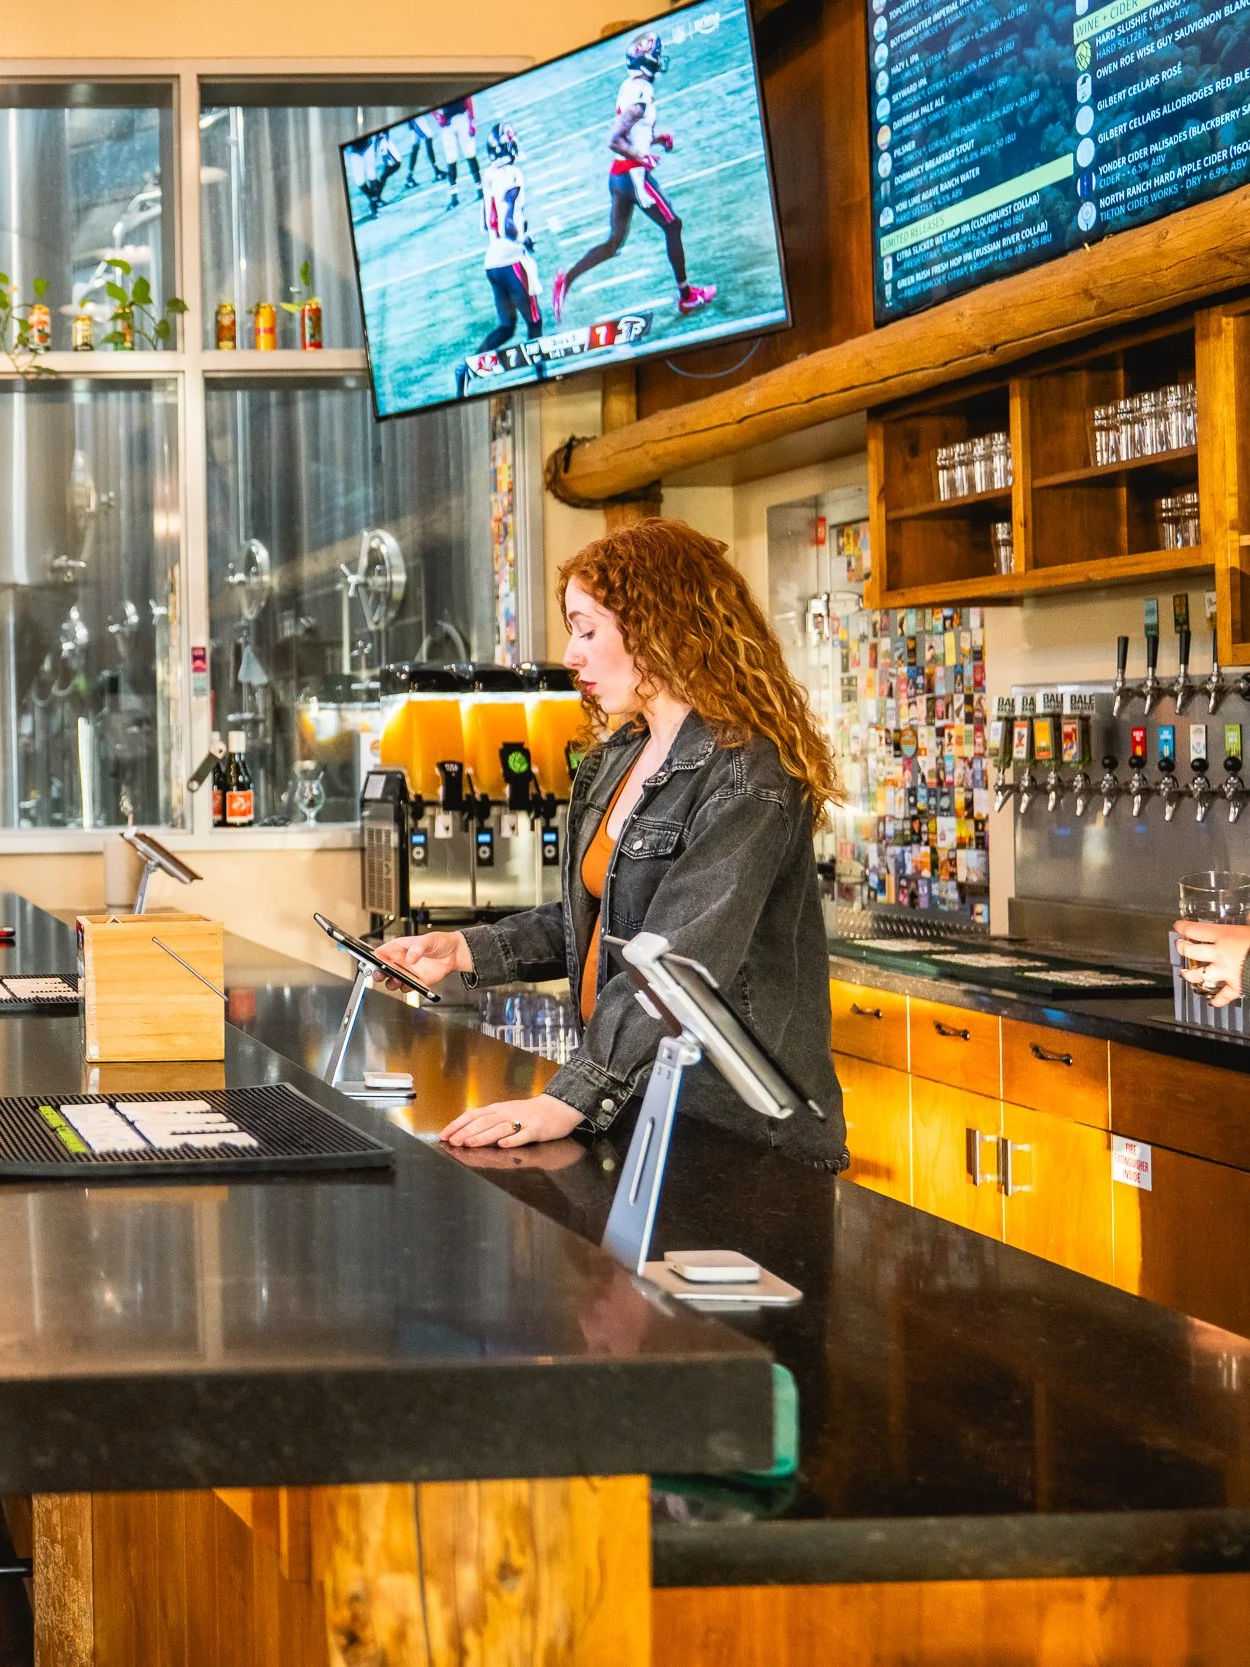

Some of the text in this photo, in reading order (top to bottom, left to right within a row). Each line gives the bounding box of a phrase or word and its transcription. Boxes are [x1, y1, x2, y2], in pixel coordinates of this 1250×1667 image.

[932, 1, 958, 24] IMPERIAL
[990, 18, 1001, 31] ABV
[1016, 4, 1027, 17] IBU
[1075, 14, 1099, 38] WINE
[1096, 27, 1115, 47] HARD
[1117, 11, 1147, 36] SLUSHIE
[1096, 4, 1190, 60] HARD SELTZER 6.3% ABV
[977, 55, 989, 67] ABV
[1003, 42, 1014, 54] IBU
[1096, 60, 1117, 79] OWEN
[1120, 51, 1134, 68] ROE
[1136, 41, 1154, 60] WISE
[1156, 33, 1172, 50] GUY
[1174, 9, 1221, 42] SAUVIGNON
[910, 51, 919, 65] IPA
[892, 76, 927, 103] SKYWARD IPA
[996, 75, 1007, 88] IBU
[1097, 59, 1182, 112] GILBERT CELLARS ROSÉ
[892, 95, 944, 131] DAYBREAK PALE ALE
[1002, 102, 1014, 115] ABV
[1028, 90, 1039, 102] IBU
[1097, 121, 1126, 144] GILBERT
[1128, 107, 1160, 130] CELLARS
[1162, 83, 1213, 116] ALLOBROGES
[1215, 75, 1231, 92] RED
[893, 139, 915, 159] PILSNER
[979, 144, 990, 156] ABV
[1005, 133, 1016, 145] IBU
[1098, 155, 1126, 176] YONDER
[1127, 145, 1148, 164] CIDER
[1149, 129, 1187, 154] PALISADES
[1188, 106, 1239, 140] (BLACKBERRY
[894, 139, 974, 186] DORMANCY BREAKFAST STOUT
[1099, 171, 1120, 189] CIDER
[1131, 159, 1149, 175] 6.5%
[1150, 152, 1165, 168] ABV
[908, 193, 920, 207] LIME
[921, 185, 938, 202] AGAVE
[939, 176, 958, 193] RANCH
[960, 166, 979, 184] WATER
[1099, 189, 1124, 209] NORTH
[1126, 178, 1151, 198] RANCH
[1153, 168, 1175, 188] HARD
[1176, 158, 1201, 178] APPLE
[1203, 147, 1227, 168] CIDER
[1100, 203, 1124, 223] TIETON
[1126, 194, 1148, 212] CIDER
[1150, 182, 1178, 203] WORKS
[1186, 173, 1201, 189] DRY
[1209, 163, 1228, 180] 6.9%
[1230, 155, 1247, 172] ABV
[951, 188, 962, 199] ABV
[882, 214, 944, 251] LIMITED RELEASES
[896, 191, 1039, 262] CITRA SLICKER WET HOP IPA (CLOUDBURST COLLAB)
[987, 222, 998, 234] ABV
[1013, 212, 1023, 224] IBU
[897, 274, 914, 290] GREEN
[931, 260, 948, 276] FRESH
[950, 254, 962, 268] HOP
[962, 250, 972, 264] IPA
[973, 238, 1000, 260] (RUSSIAN
[1002, 231, 1020, 248] RIVER
[1021, 219, 1047, 241] COLLAB)
[1014, 242, 1026, 254] ABV
[1040, 232, 1051, 244] IBU
[595, 325, 608, 345] 7
[506, 348, 518, 368] 7
[1070, 694, 1094, 704] BALE
[1125, 1143, 1137, 1154] FIRE
[1115, 1152, 1149, 1172] EXTINGUISHER
[1123, 1169, 1141, 1184] INSIDE
